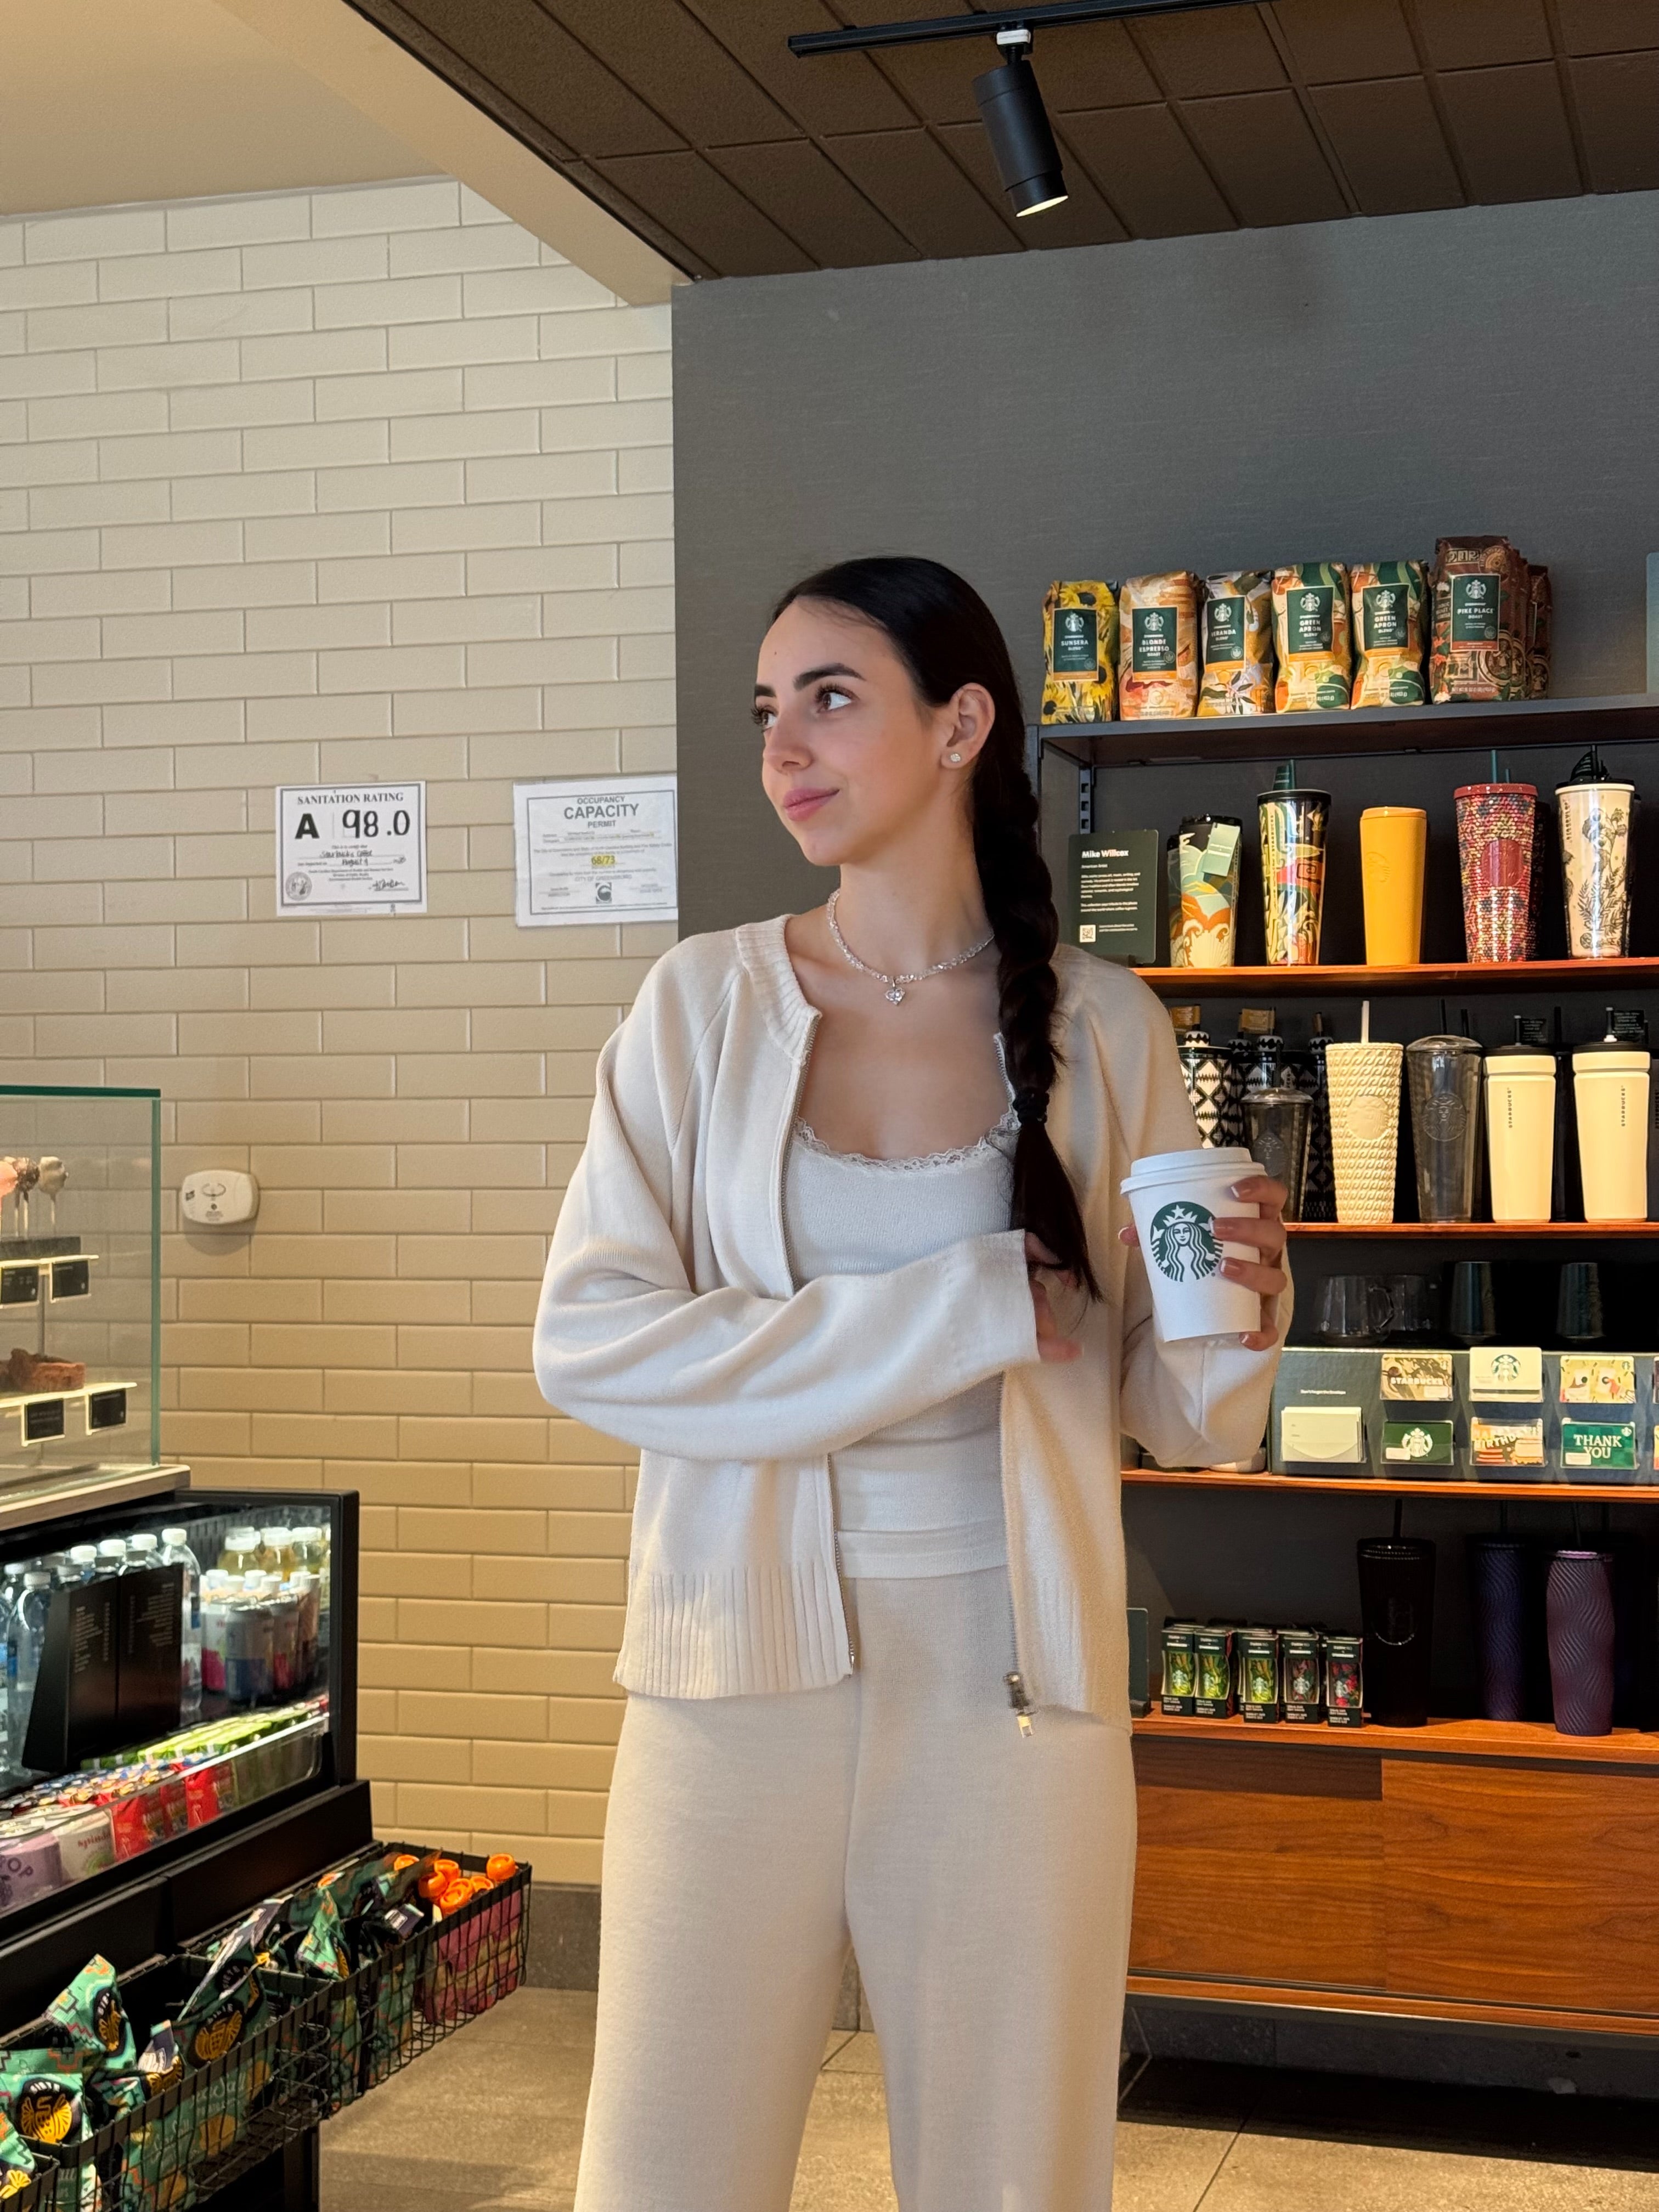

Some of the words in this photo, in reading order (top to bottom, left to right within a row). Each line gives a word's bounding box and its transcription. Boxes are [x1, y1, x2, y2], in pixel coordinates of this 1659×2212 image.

[297, 793, 360, 805] SANITATION
[363, 792, 404, 803] RATING
[577, 795, 625, 804] OCCUPANCY
[564, 803, 639, 820] CAPACITY
[295, 813, 320, 839] A
[342, 809, 410, 839] 98.0
[588, 820, 616, 828] PERMIT
[591, 855, 615, 865] 68/73
[1390, 1377, 1443, 1385] STARBUCKS
[1573, 1434, 1622, 1447] THANK
[1583, 1446, 1612, 1459] YOU
